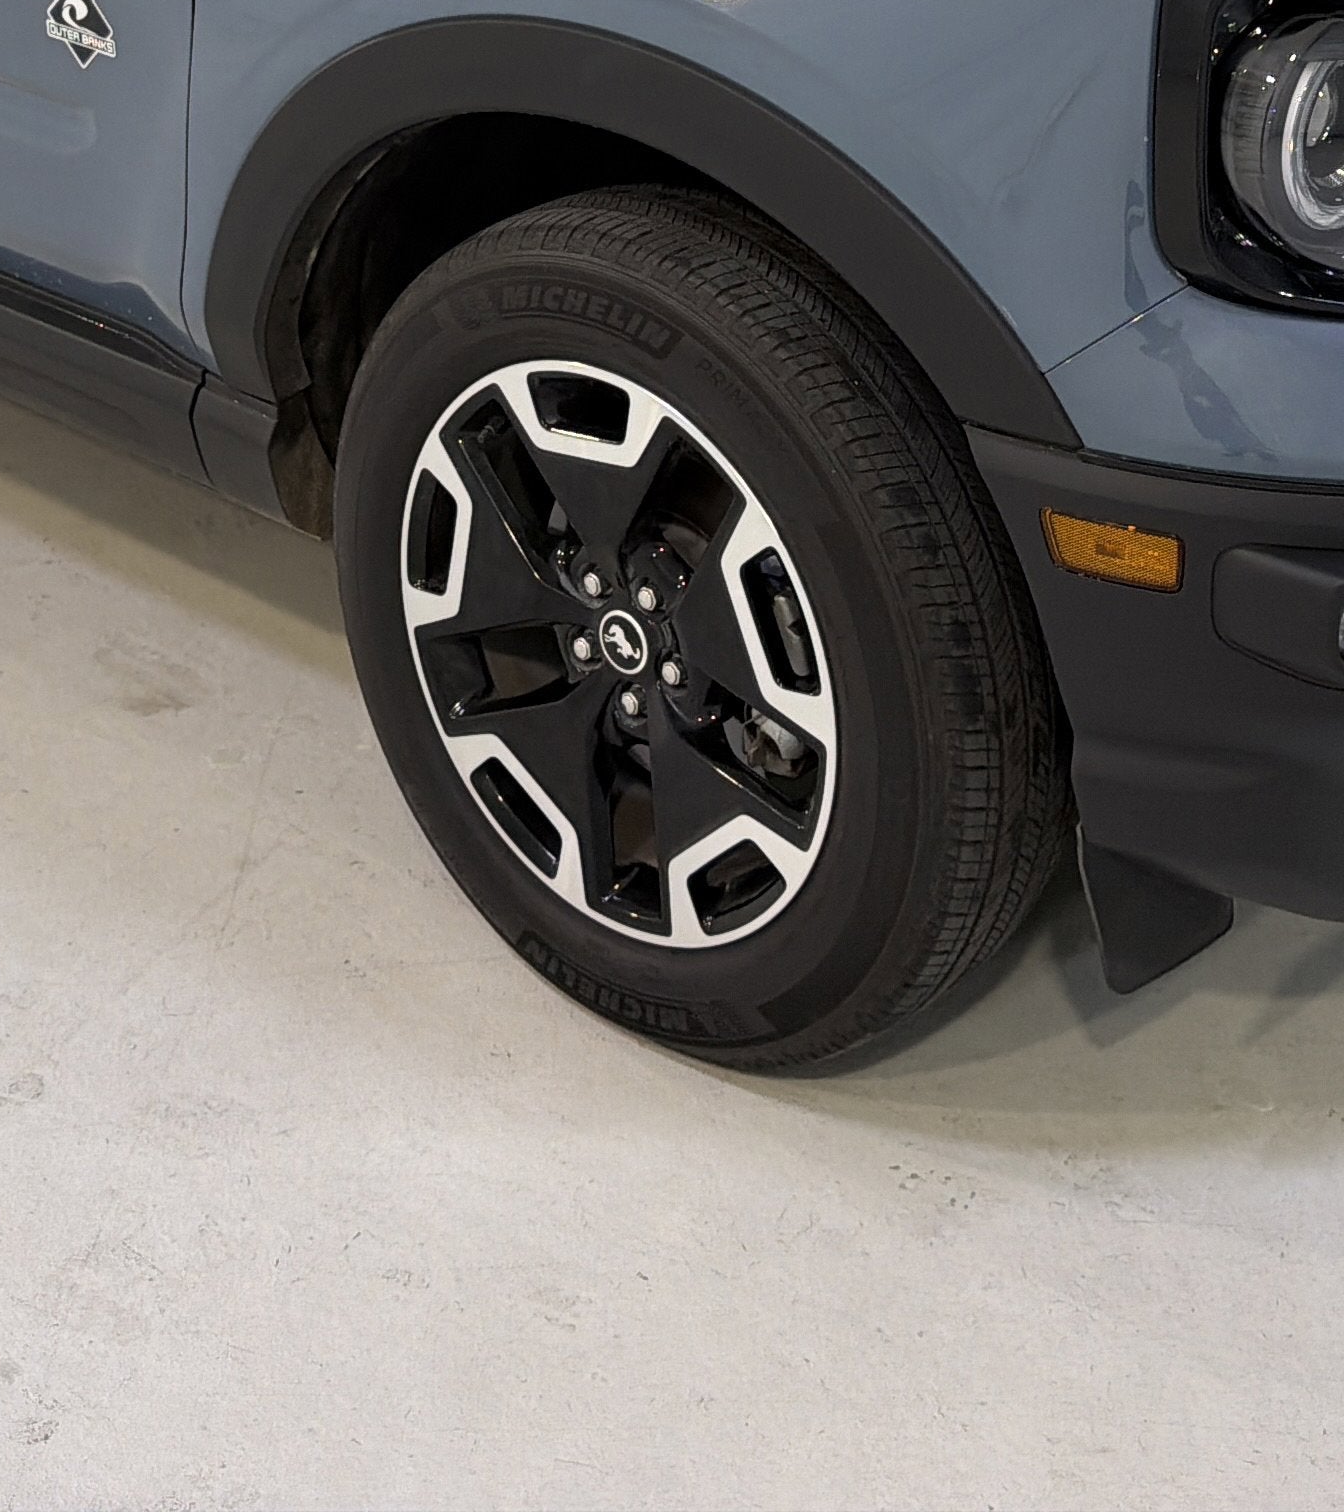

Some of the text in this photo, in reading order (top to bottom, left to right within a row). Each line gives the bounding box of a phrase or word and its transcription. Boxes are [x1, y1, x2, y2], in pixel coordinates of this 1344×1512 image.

[49, 23, 114, 53] OUTER BANKS
[501, 285, 672, 350] MICHELIN
[523, 939, 689, 1033] MICHELIN
